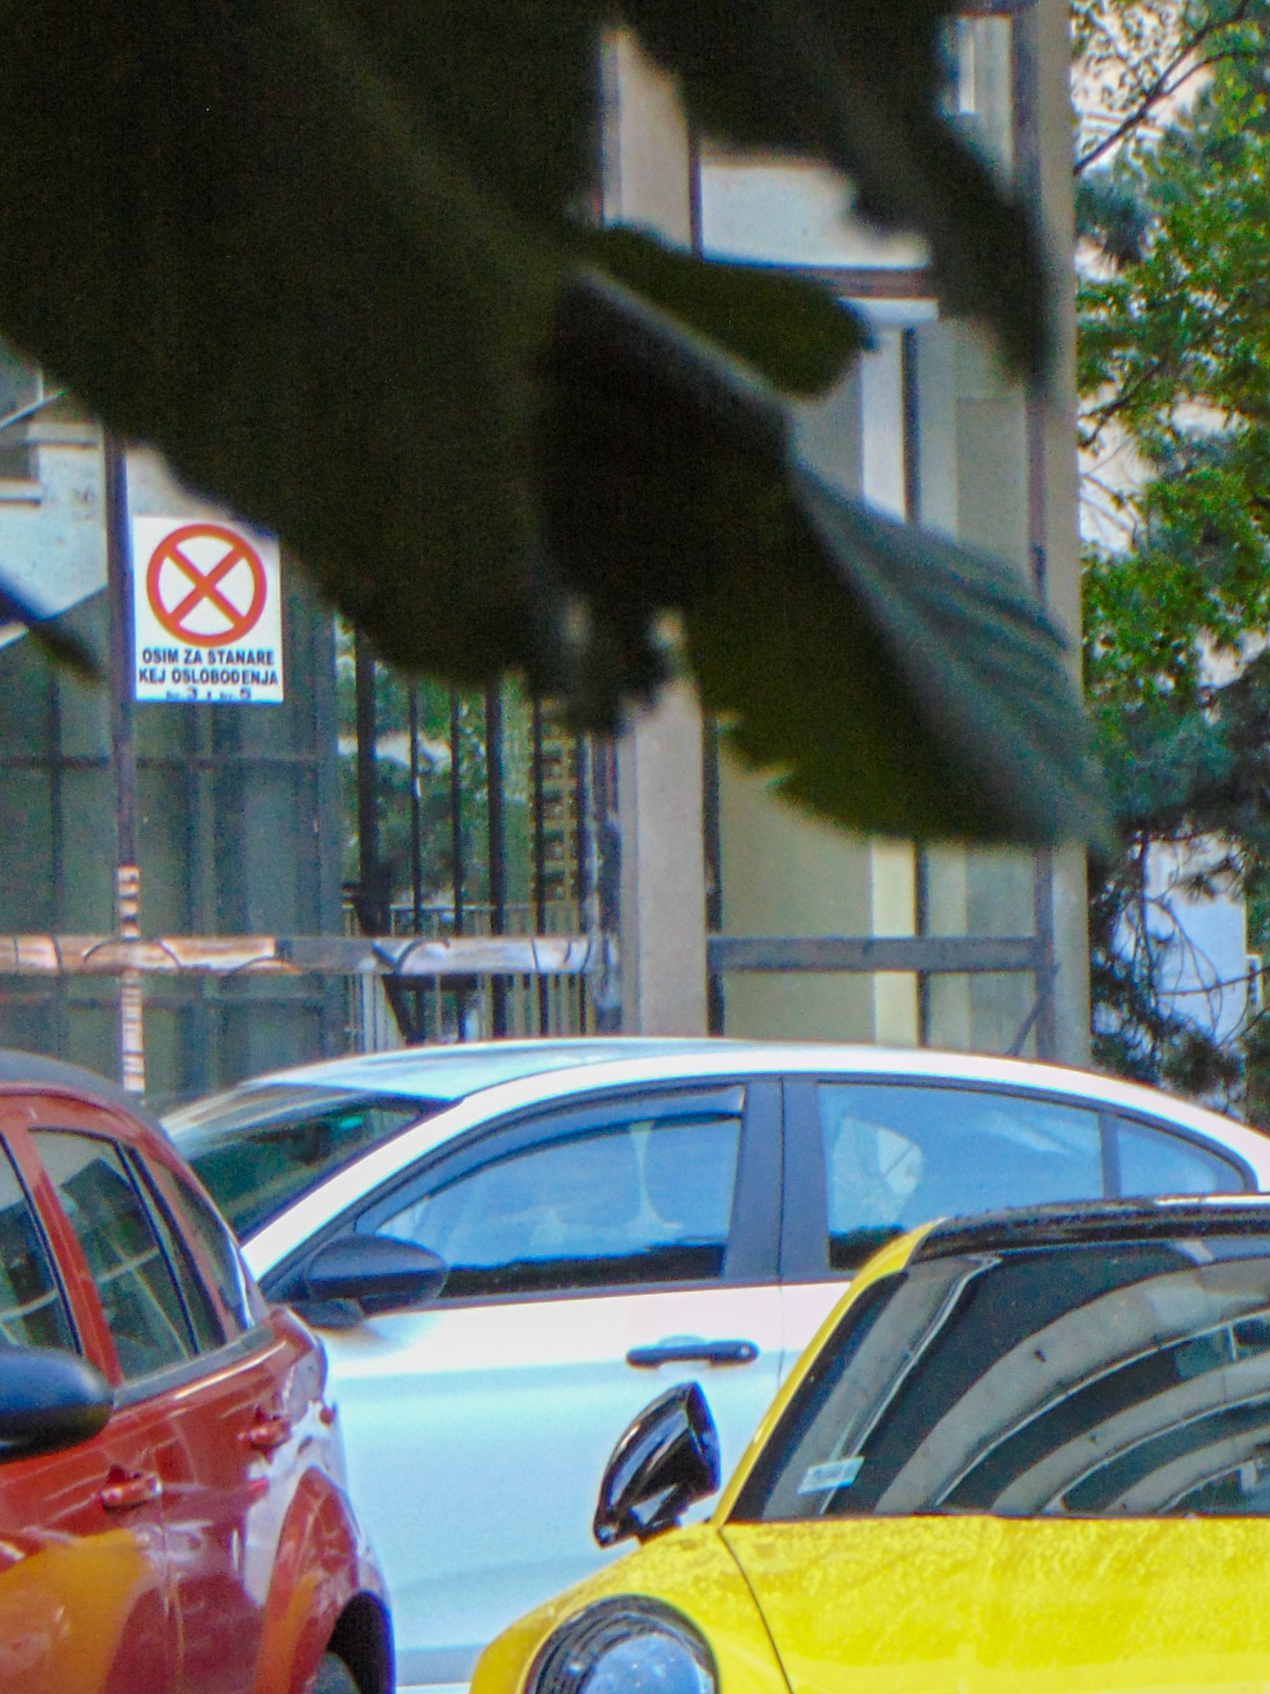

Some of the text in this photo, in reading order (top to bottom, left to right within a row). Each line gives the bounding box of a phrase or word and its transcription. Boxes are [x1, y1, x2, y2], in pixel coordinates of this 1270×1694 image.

[142, 649, 274, 665] OSIM ZA STANARE
[139, 668, 166, 682] KEJ
